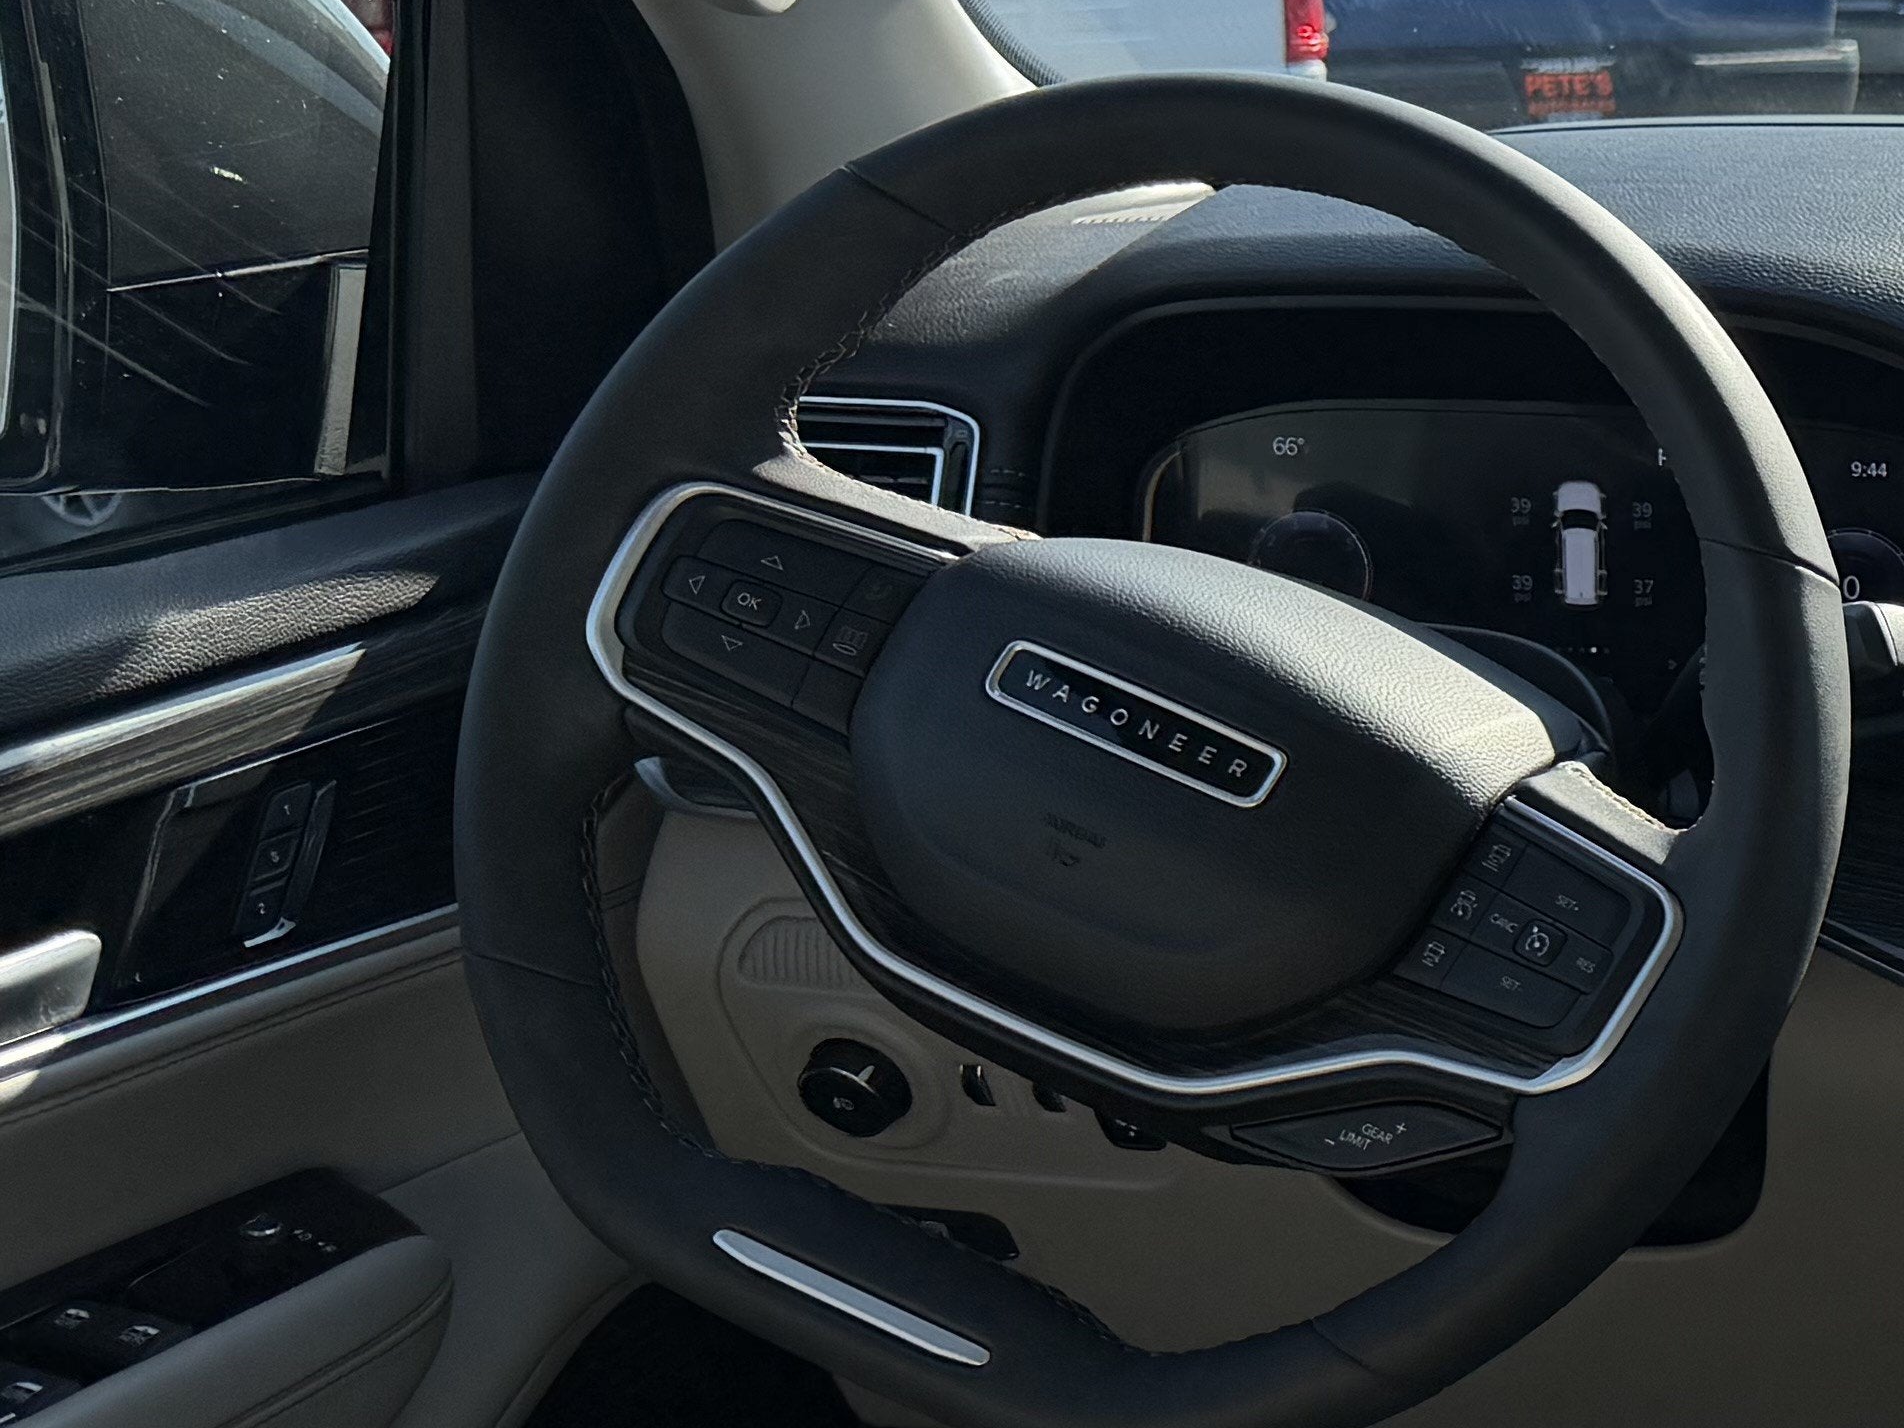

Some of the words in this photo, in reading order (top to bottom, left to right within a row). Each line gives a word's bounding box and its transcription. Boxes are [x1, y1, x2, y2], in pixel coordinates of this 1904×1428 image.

[1850, 461, 1888, 478] 9:44
[1510, 497, 1532, 514] 39
[1632, 502, 1654, 518] 39
[1512, 575, 1534, 591] 39
[736, 592, 763, 611] OK
[1025, 670, 1248, 777] WAGONEER
[1361, 1123, 1394, 1145] GEAR
